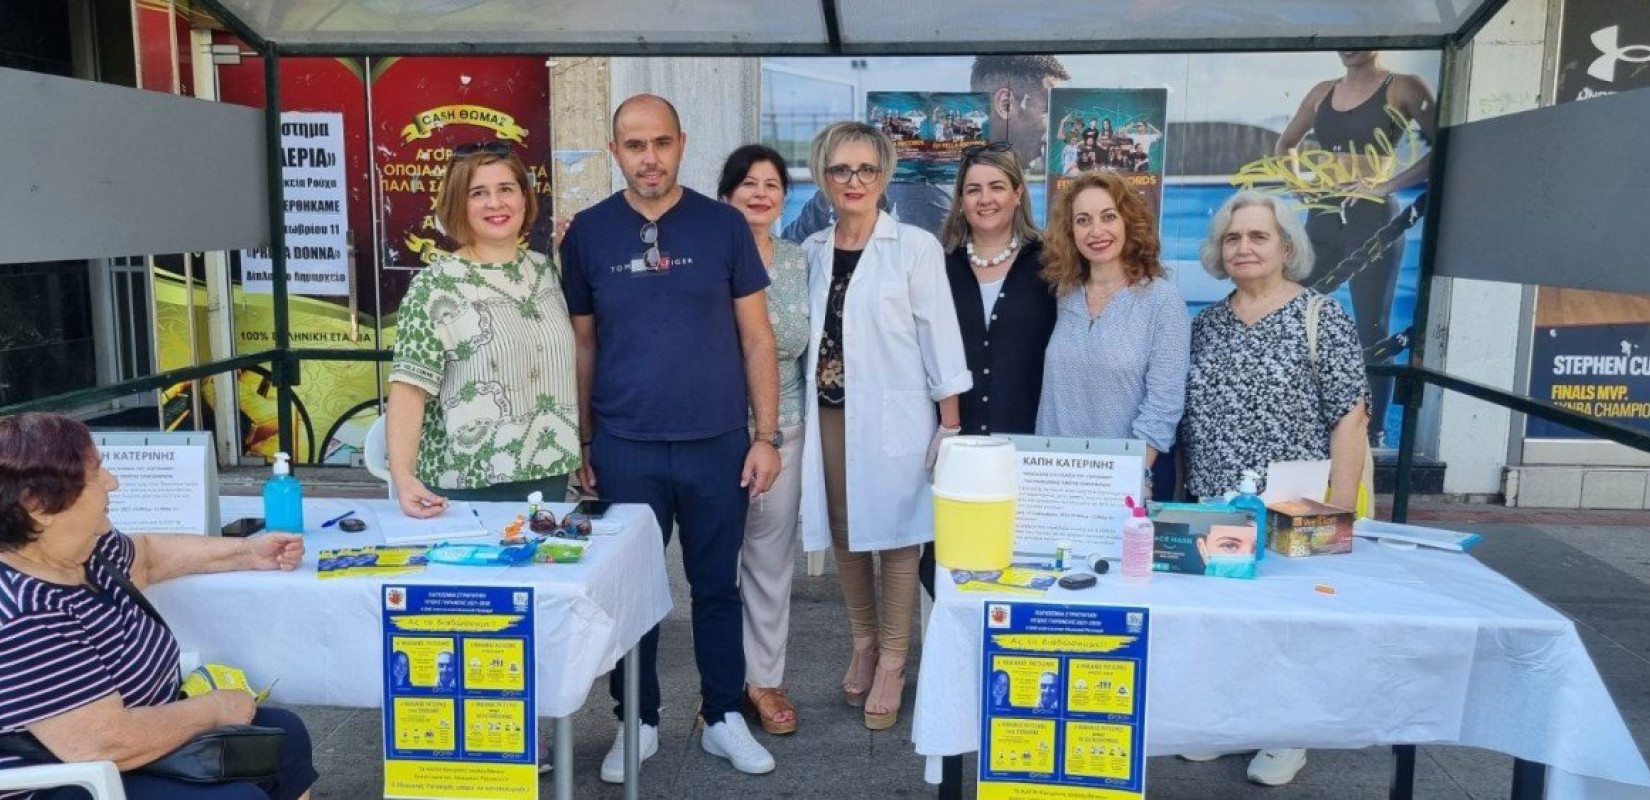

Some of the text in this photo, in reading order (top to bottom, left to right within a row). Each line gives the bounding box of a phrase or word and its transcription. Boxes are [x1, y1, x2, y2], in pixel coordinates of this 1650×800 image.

[422, 110, 508, 127] CASH ΘΩΜΑΣ
[281, 122, 329, 138] στημα
[416, 147, 454, 161] ΑΓΟΡ
[284, 178, 305, 188] κεία
[382, 179, 425, 193] ΠΑΛΑ
[1127, 175, 1156, 186] ORDS
[284, 200, 340, 213] ΕΡΘΗΚΑΜΕ
[284, 224, 328, 235] τωβρίου
[241, 332, 269, 342] 100%
[275, 331, 327, 342] ΕΛΗΝΙΚΗ
[1553, 355, 1650, 376] STEPHEN CU
[1551, 384, 1629, 401] FINALS MVP.
[1594, 402, 1650, 418] CHAMPIO
[113, 451, 176, 461] ΚΑΤΕΡΙΝΗΣ
[1022, 456, 1115, 470] ΚΑΠΗ ΚΑΤΕΡΙΝΗΣ
